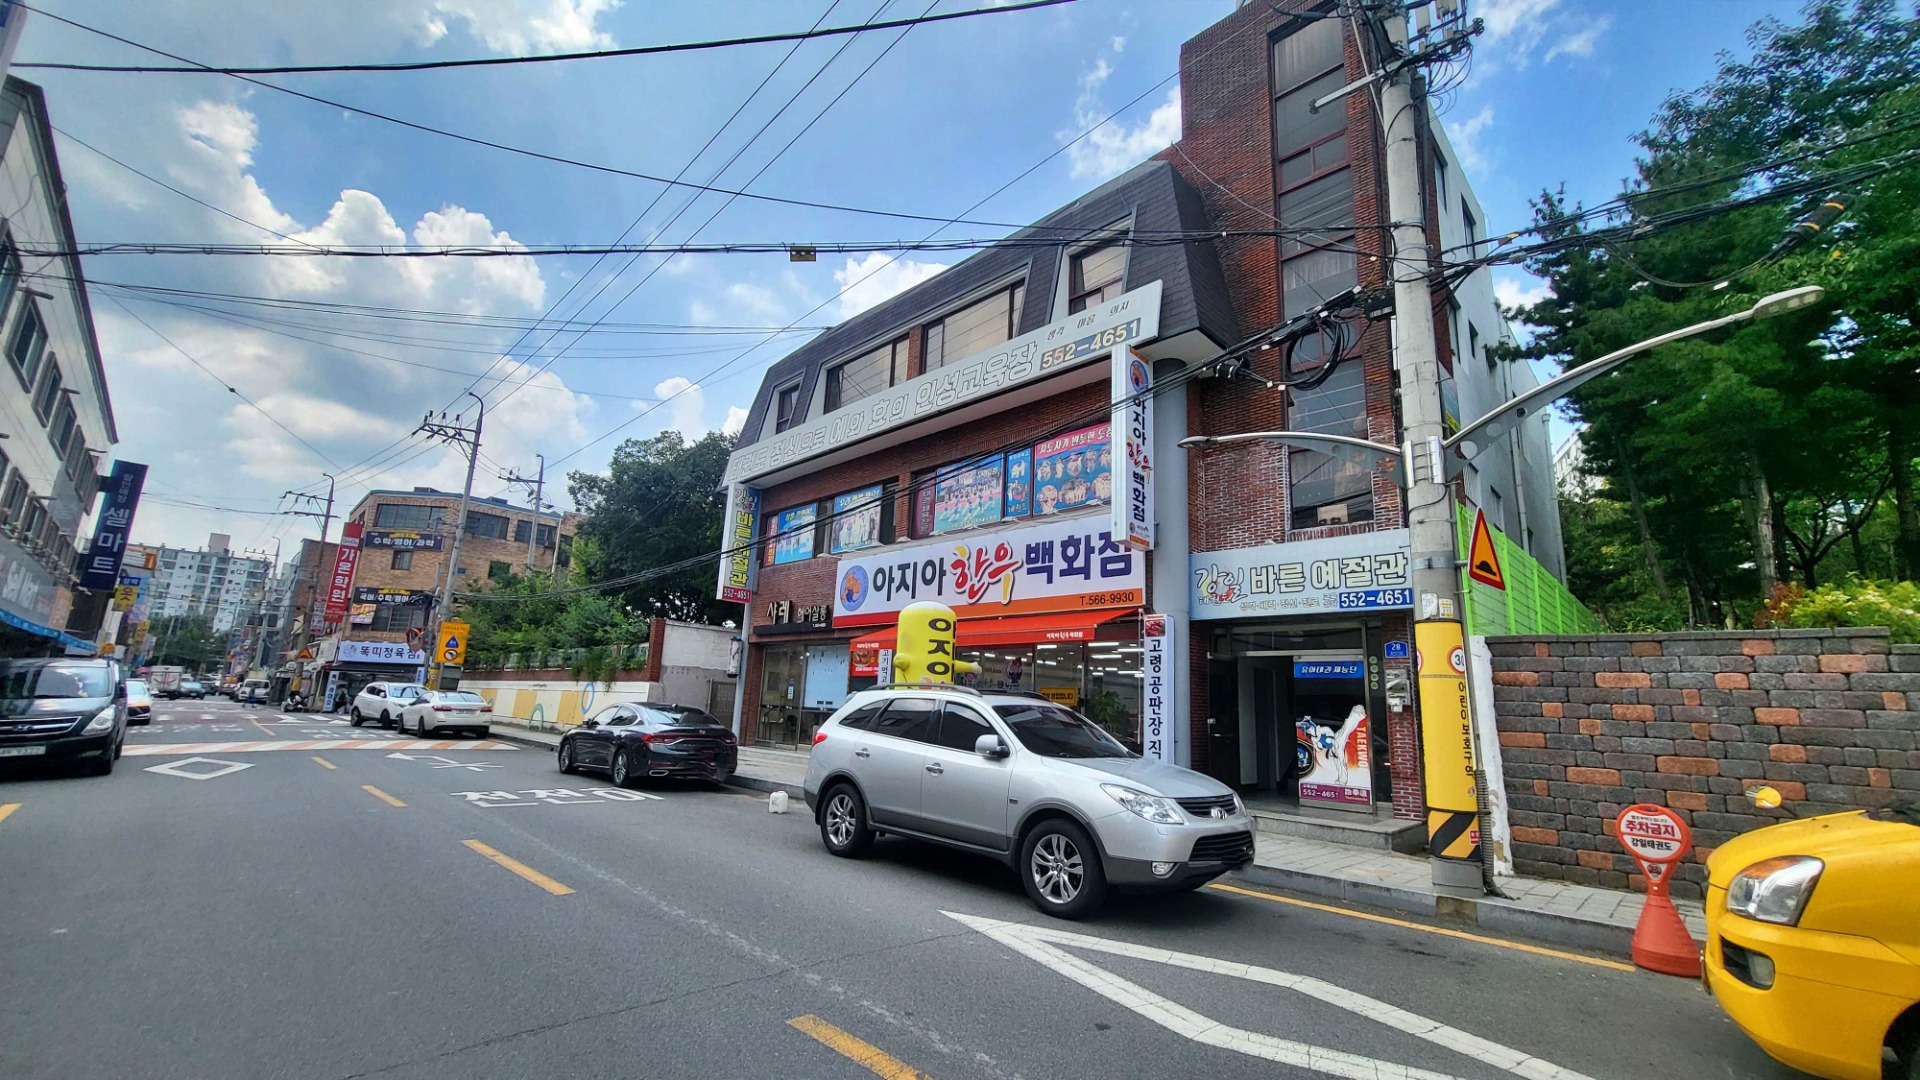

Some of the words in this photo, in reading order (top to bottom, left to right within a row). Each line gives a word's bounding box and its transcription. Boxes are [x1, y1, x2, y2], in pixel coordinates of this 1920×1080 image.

[1047, 326, 1064, 340] 생각
[1077, 313, 1096, 329] 마음
[1108, 300, 1129, 316] 의지
[1041, 319, 1139, 370] 552-4651
[770, 426, 827, 467] 정신으로
[914, 341, 1038, 415] 인성교육장
[1127, 436, 1153, 485] 한우
[1132, 470, 1145, 523] 백화점
[88, 507, 130, 574] 셀마트
[331, 548, 355, 602] 가온학원
[872, 557, 947, 602] 아지아
[950, 542, 1021, 603] 한우
[1025, 531, 1132, 585] 백화점
[1194, 563, 1248, 604] 강일
[1249, 561, 1306, 595] 바른
[1310, 552, 1409, 590] 예절관
[723, 587, 751, 600] 552-4651
[797, 605, 827, 624] 헤어살롱
[1079, 591, 1135, 606] T.566-9930
[1340, 588, 1411, 608] 552-4651
[360, 645, 417, 660] 똑띠정육점
[926, 617, 957, 683] 아지아
[1391, 643, 1401, 651] 28
[1148, 639, 1163, 736] 고령공판장
[1302, 788, 1339, 799] 552-4651
[1626, 820, 1676, 837] 주차금지
[1630, 837, 1672, 851] 강일태권도
